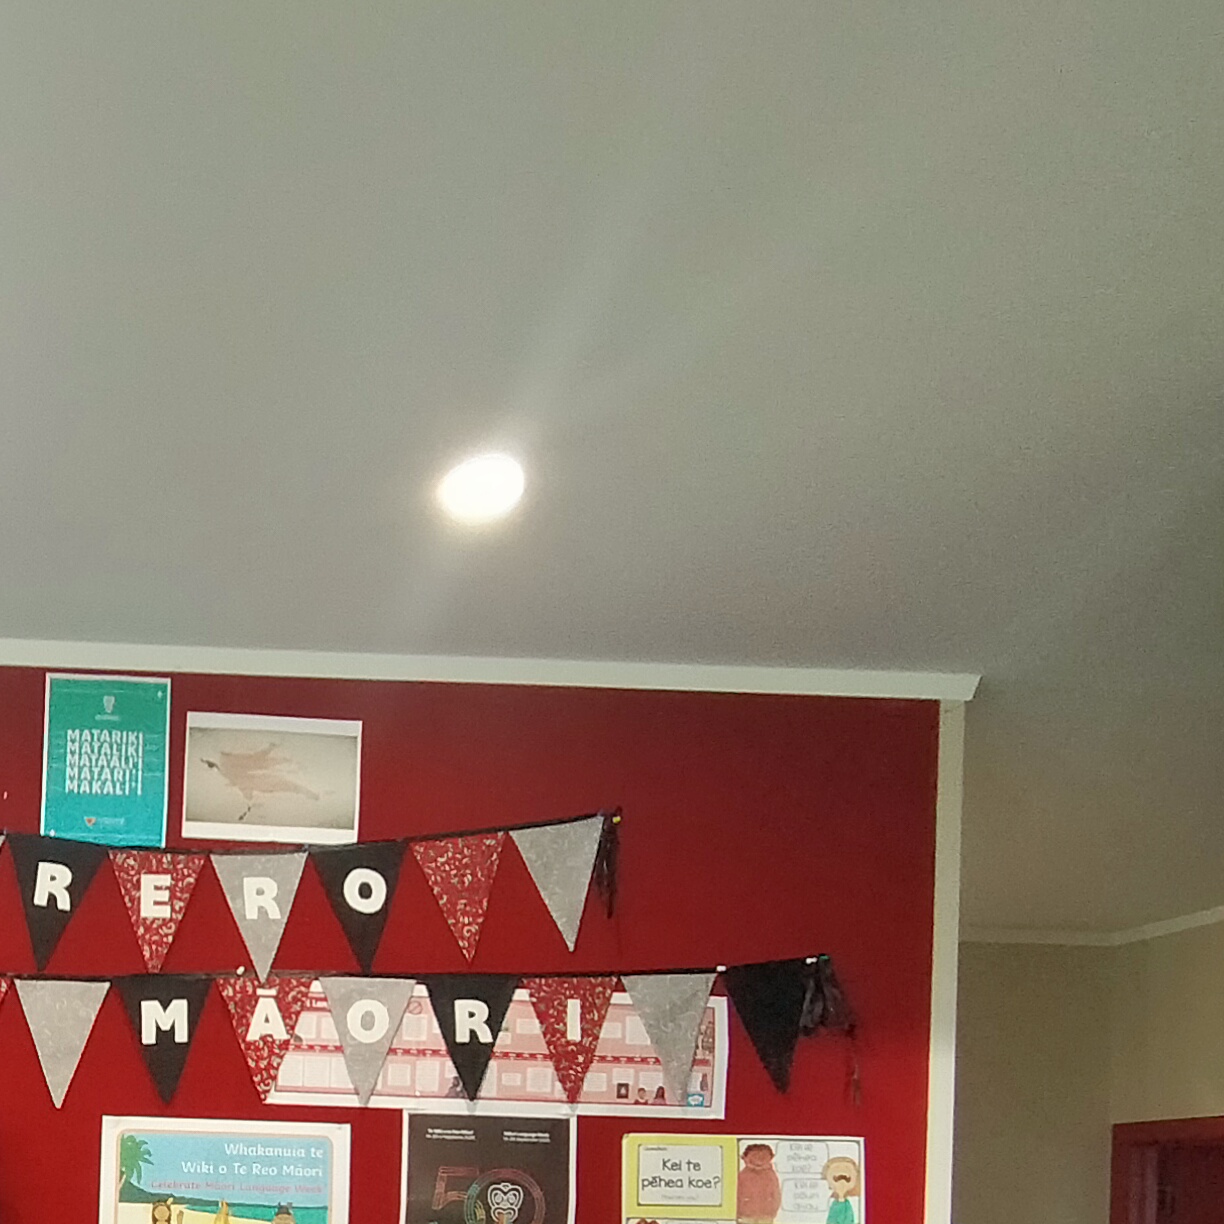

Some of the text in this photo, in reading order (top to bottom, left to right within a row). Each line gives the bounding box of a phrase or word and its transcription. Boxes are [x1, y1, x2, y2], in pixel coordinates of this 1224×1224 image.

[67, 729, 143, 744] MATARIKI
[67, 742, 143, 756] MATALIKI
[224, 1143, 324, 1159] Whakanuia te
[181, 1161, 214, 1174] Wiki
[218, 1165, 228, 1175] o
[233, 1162, 248, 1175] Te
[252, 1163, 278, 1176] Reo
[662, 1158, 702, 1172] Kei te
[688, 1175, 721, 1189] koe?
